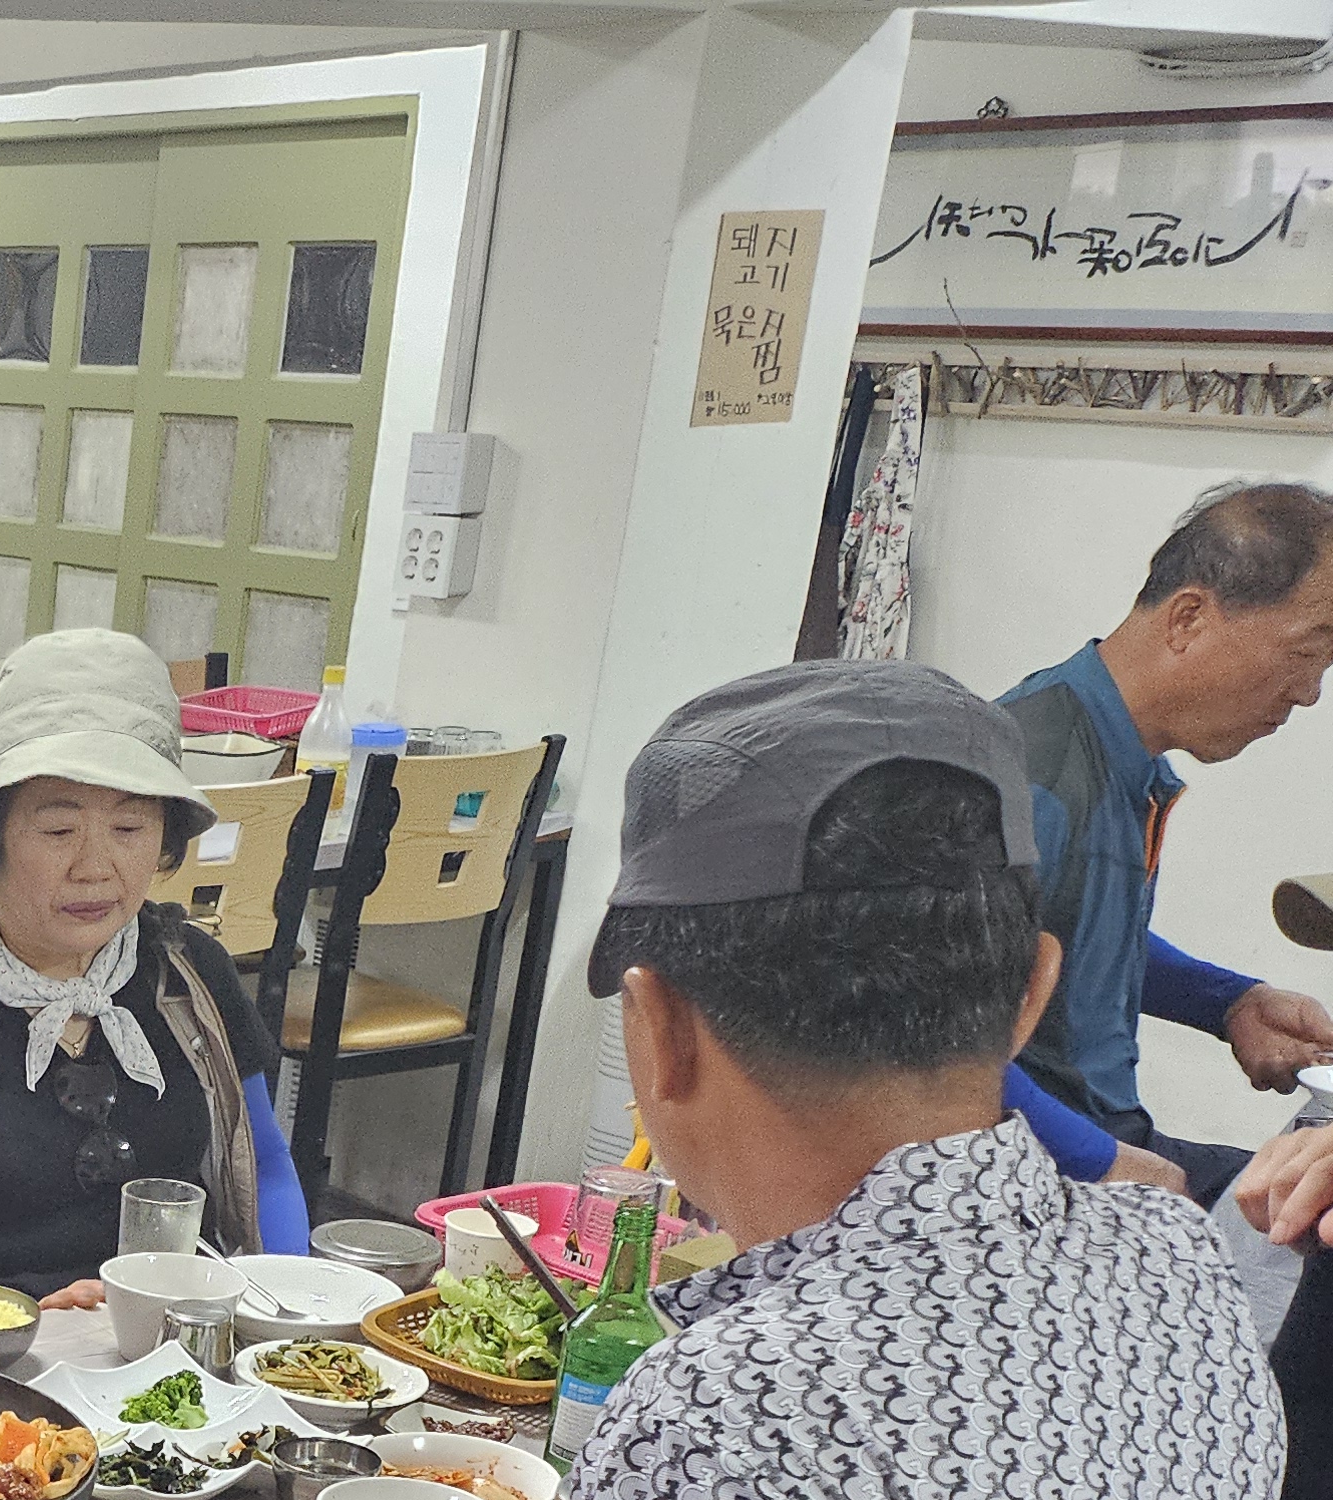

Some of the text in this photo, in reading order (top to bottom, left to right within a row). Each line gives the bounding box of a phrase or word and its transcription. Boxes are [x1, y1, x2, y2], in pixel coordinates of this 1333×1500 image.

[731, 223, 797, 258] 돼지
[734, 263, 789, 292] 고기
[751, 338, 782, 385] 찜
